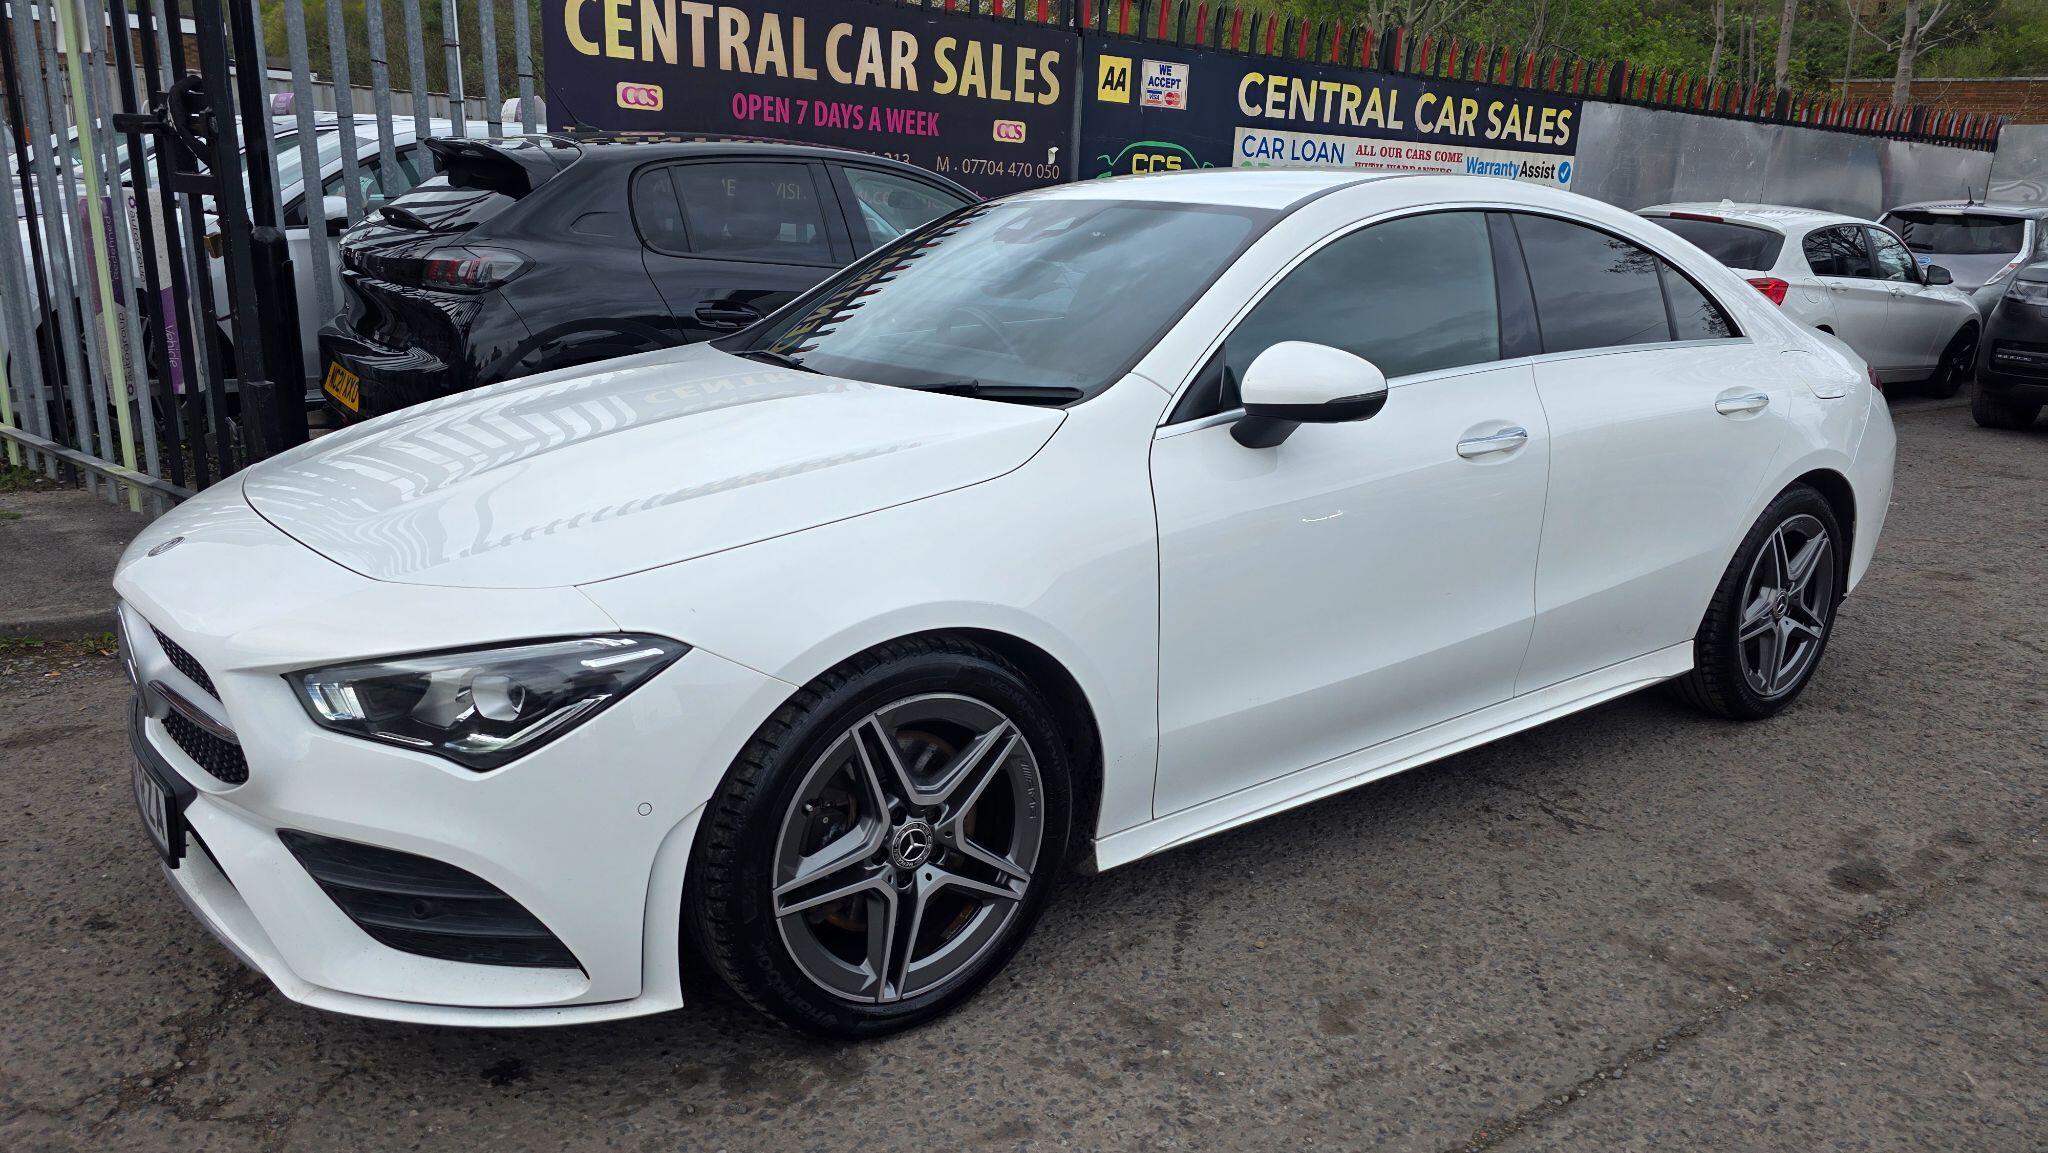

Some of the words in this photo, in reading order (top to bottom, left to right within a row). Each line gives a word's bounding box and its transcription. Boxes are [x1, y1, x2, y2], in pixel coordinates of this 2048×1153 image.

[565, 0, 817, 80] CENTRAL
[825, 22, 919, 92] CAR
[932, 36, 1060, 105] SALES
[1102, 66, 1127, 92] AA
[1159, 64, 1172, 76] WE
[1147, 76, 1181, 89] ACCEPT
[621, 85, 659, 107] CCS
[732, 92, 790, 123] OPEN
[797, 100, 808, 126] 7
[814, 101, 864, 130] DAYS
[868, 106, 881, 132] A
[886, 108, 939, 136] WEEK
[1238, 71, 1404, 131] CENTRAL
[1414, 93, 1477, 137] CAR
[1484, 100, 1573, 146] SALES
[996, 123, 1023, 140] CCS
[1241, 134, 1284, 160] CAR
[1292, 139, 1345, 164] LOAN
[1355, 144, 1376, 156] ALL
[1380, 146, 1403, 159] OUR
[1405, 148, 1431, 161] CARS
[1434, 150, 1463, 163] COME
[936, 155, 949, 172] M
[963, 158, 1003, 175] 07704
[1008, 161, 1032, 177] 470
[1036, 163, 1060, 179] 050
